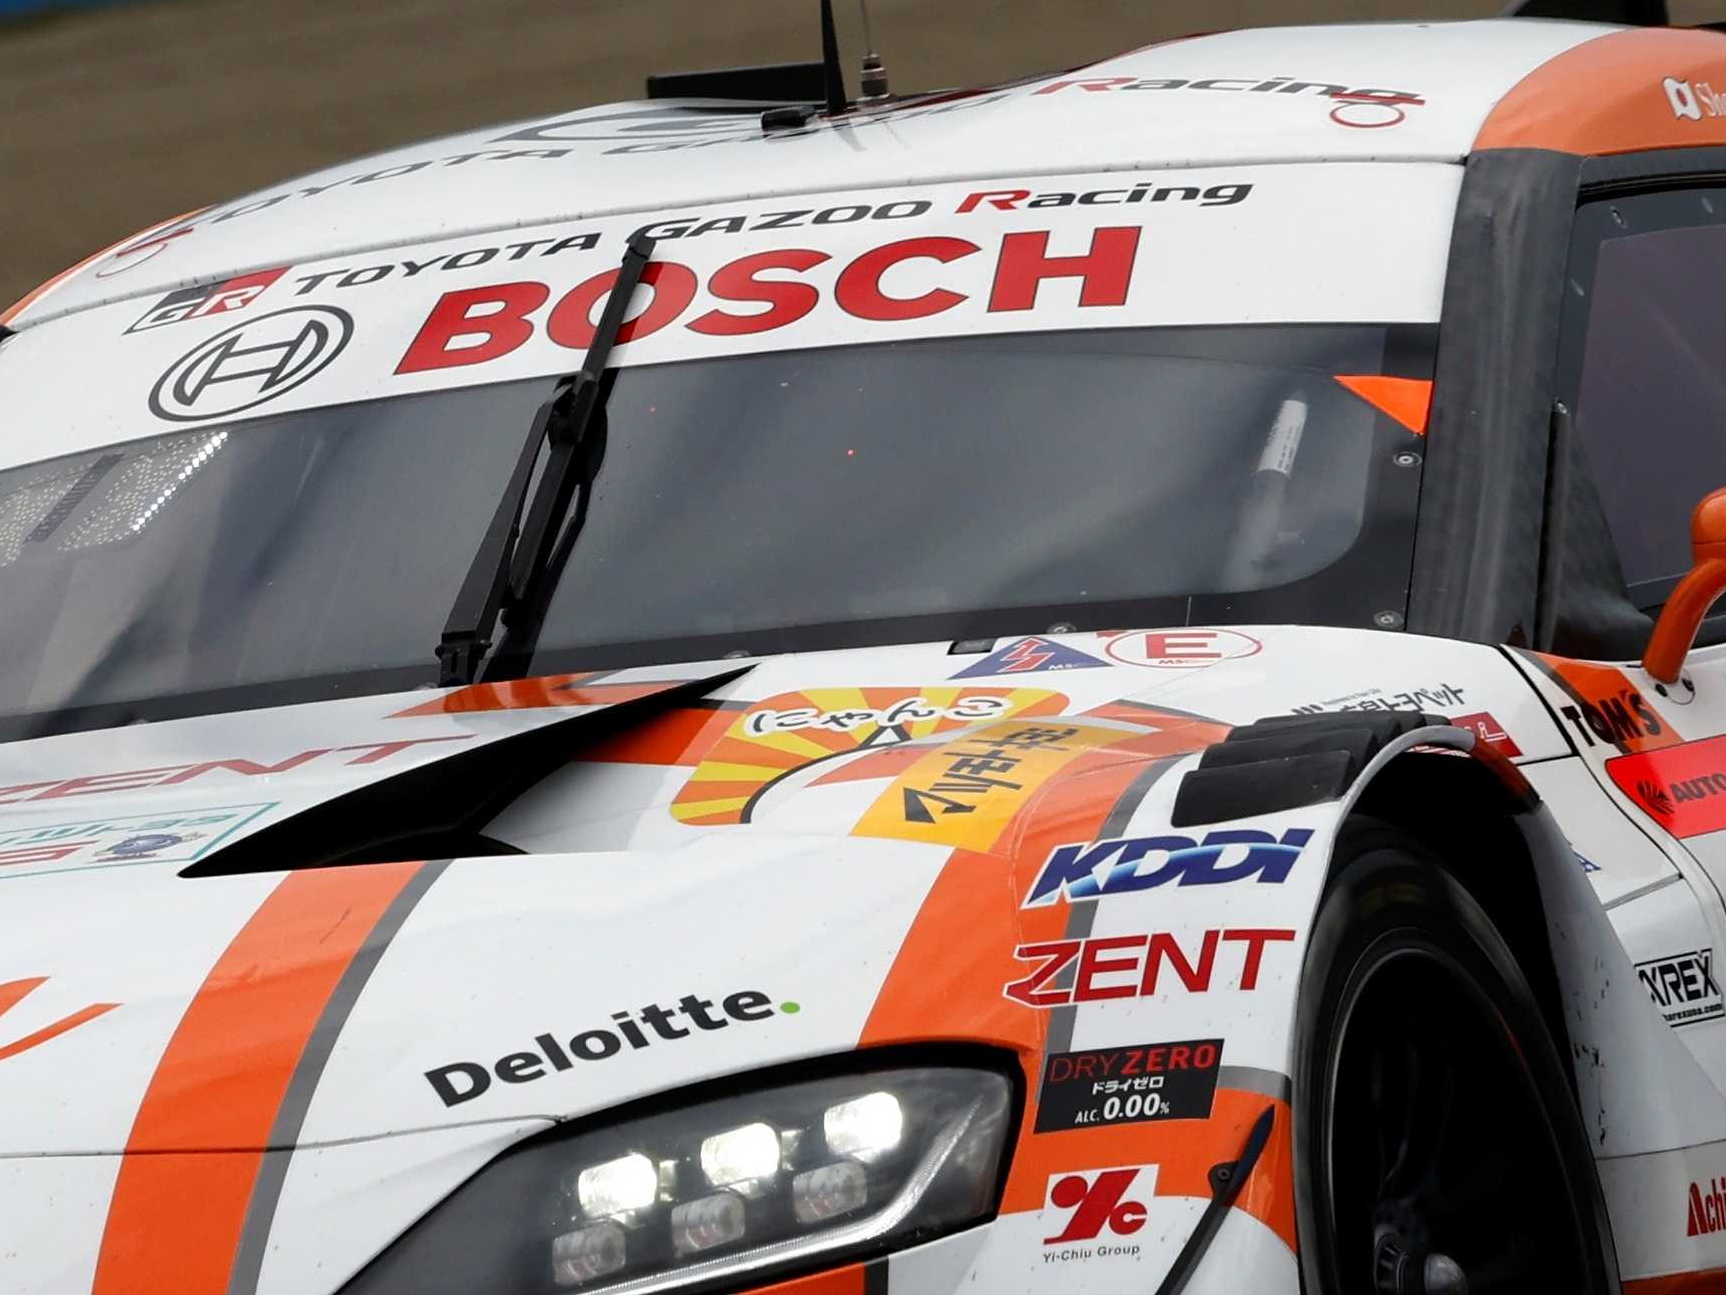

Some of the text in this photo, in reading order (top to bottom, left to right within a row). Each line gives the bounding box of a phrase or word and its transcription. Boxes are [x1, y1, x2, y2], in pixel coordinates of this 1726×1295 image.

[294, 181, 1254, 296] TOYOTA GAZOO Racing
[393, 225, 1142, 375] BOSCH
[747, 695, 1009, 735] にゃんこ
[1561, 688, 1662, 747] TOM'S
[1024, 827, 1316, 909] KDDI
[1005, 929, 1298, 1008] ZENT
[1075, 1093, 1170, 1124] ALC. 0.00%
[1092, 1075, 1164, 1096] ドライゼロ
[1097, 1243, 1141, 1259] Group
